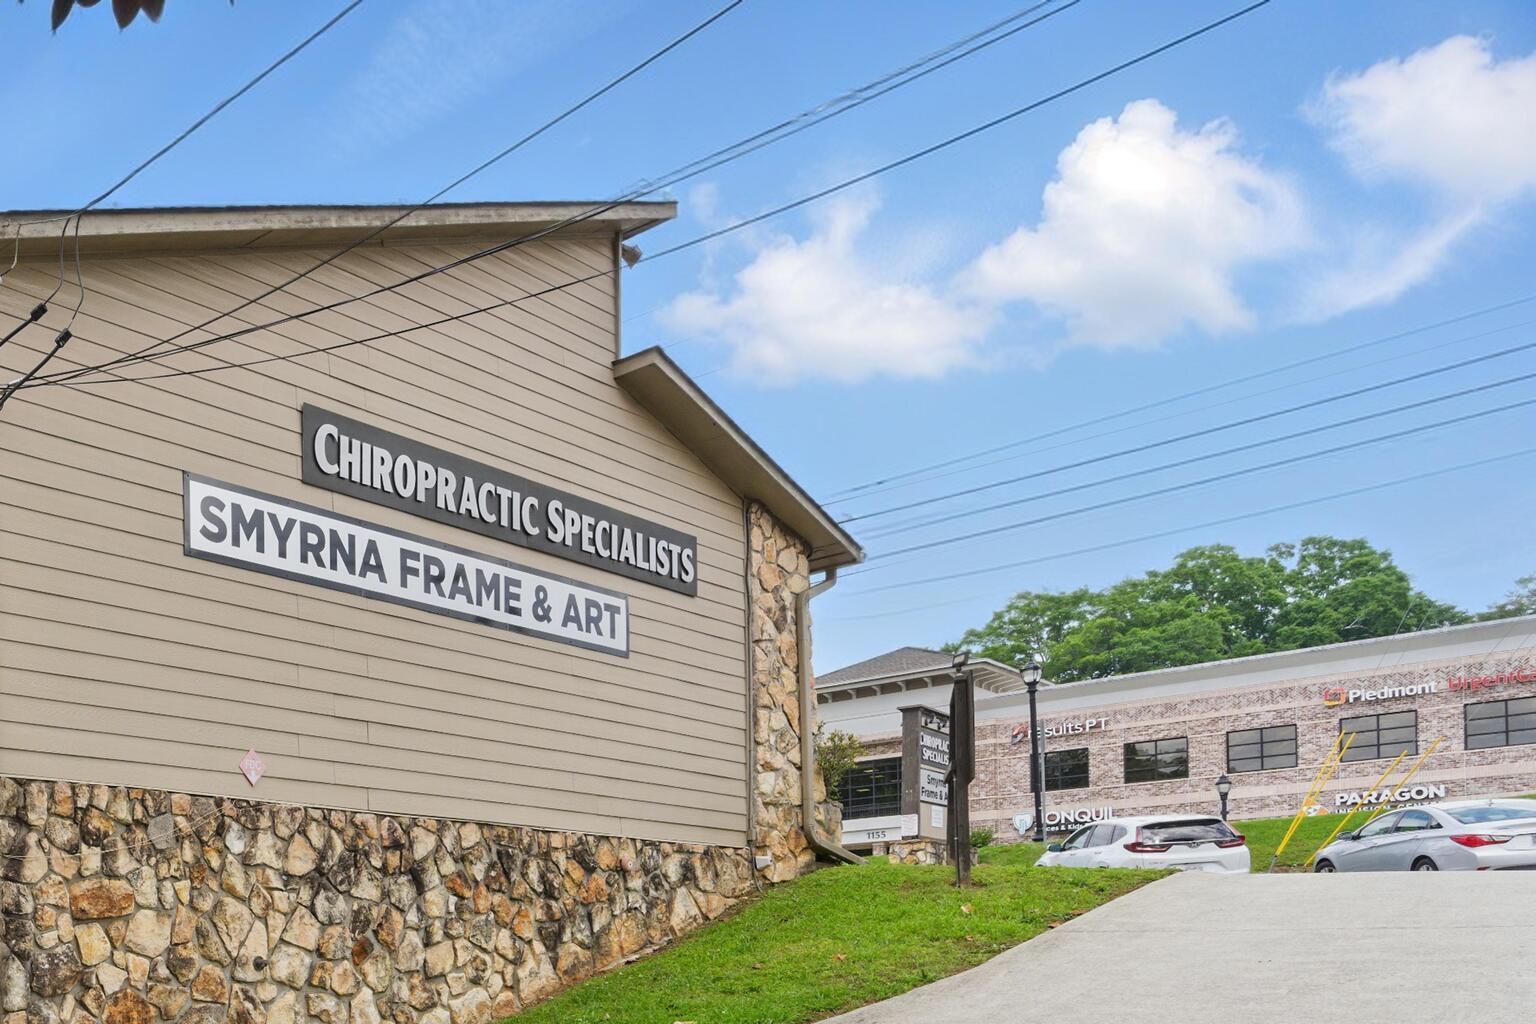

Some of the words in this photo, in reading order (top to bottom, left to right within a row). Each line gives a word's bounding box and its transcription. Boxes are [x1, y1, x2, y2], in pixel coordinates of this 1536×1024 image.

[314, 423, 539, 536] CHIROPRACTIC
[546, 499, 694, 583] SPECIALISTS
[199, 495, 388, 584] SMYRNA
[400, 547, 522, 617] FRAME
[534, 584, 553, 624] &
[561, 594, 622, 641] ART
[1349, 680, 1437, 703] Piedmont
[1085, 718, 1109, 732] PT
[921, 786, 938, 799] Frame
[1335, 784, 1446, 806] PARAGON
[1041, 806, 1117, 825] ONQUIL
[866, 830, 886, 840] 1155
